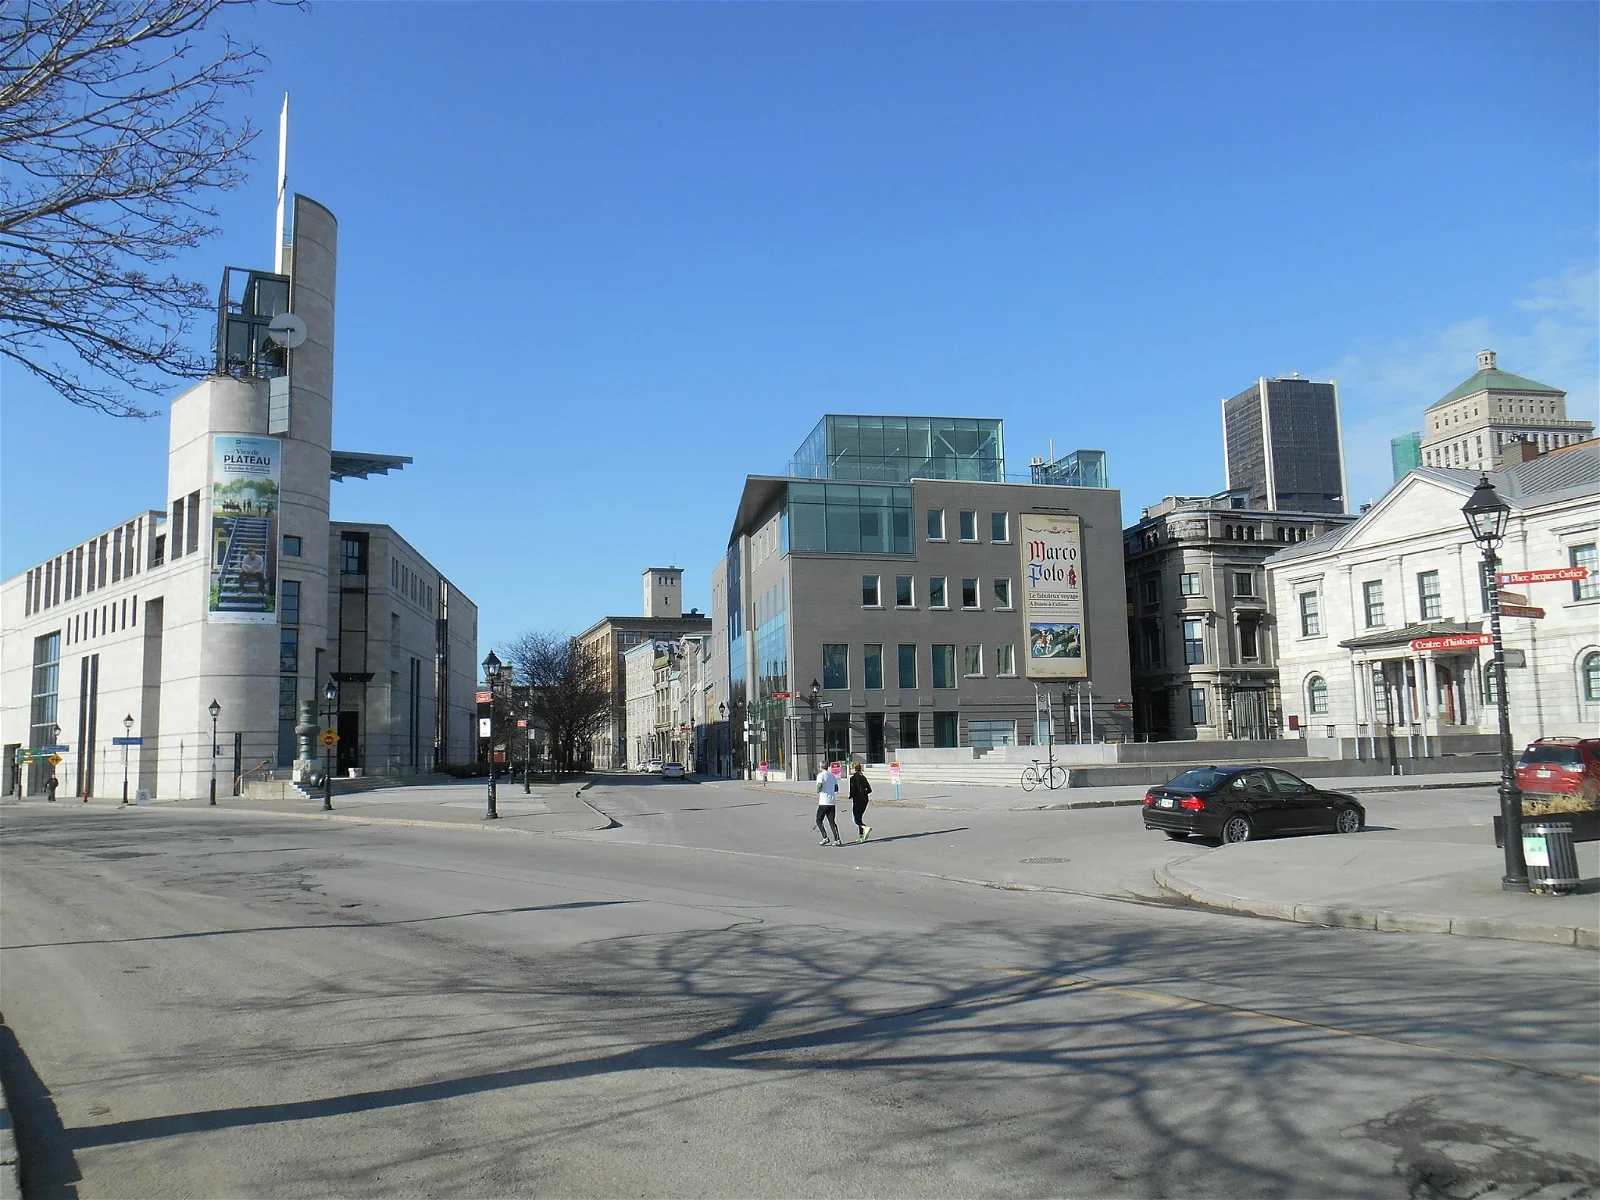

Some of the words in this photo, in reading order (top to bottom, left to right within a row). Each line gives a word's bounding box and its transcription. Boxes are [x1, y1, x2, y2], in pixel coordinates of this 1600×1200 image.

[224, 455, 270, 465] PLATEAU
[1026, 540, 1077, 562] Marco
[1027, 562, 1064, 589] Polo
[1511, 573, 1529, 582] Place
[1530, 570, 1583, 582] Jacques-Cartier
[1443, 638, 1479, 646] d'histoire
